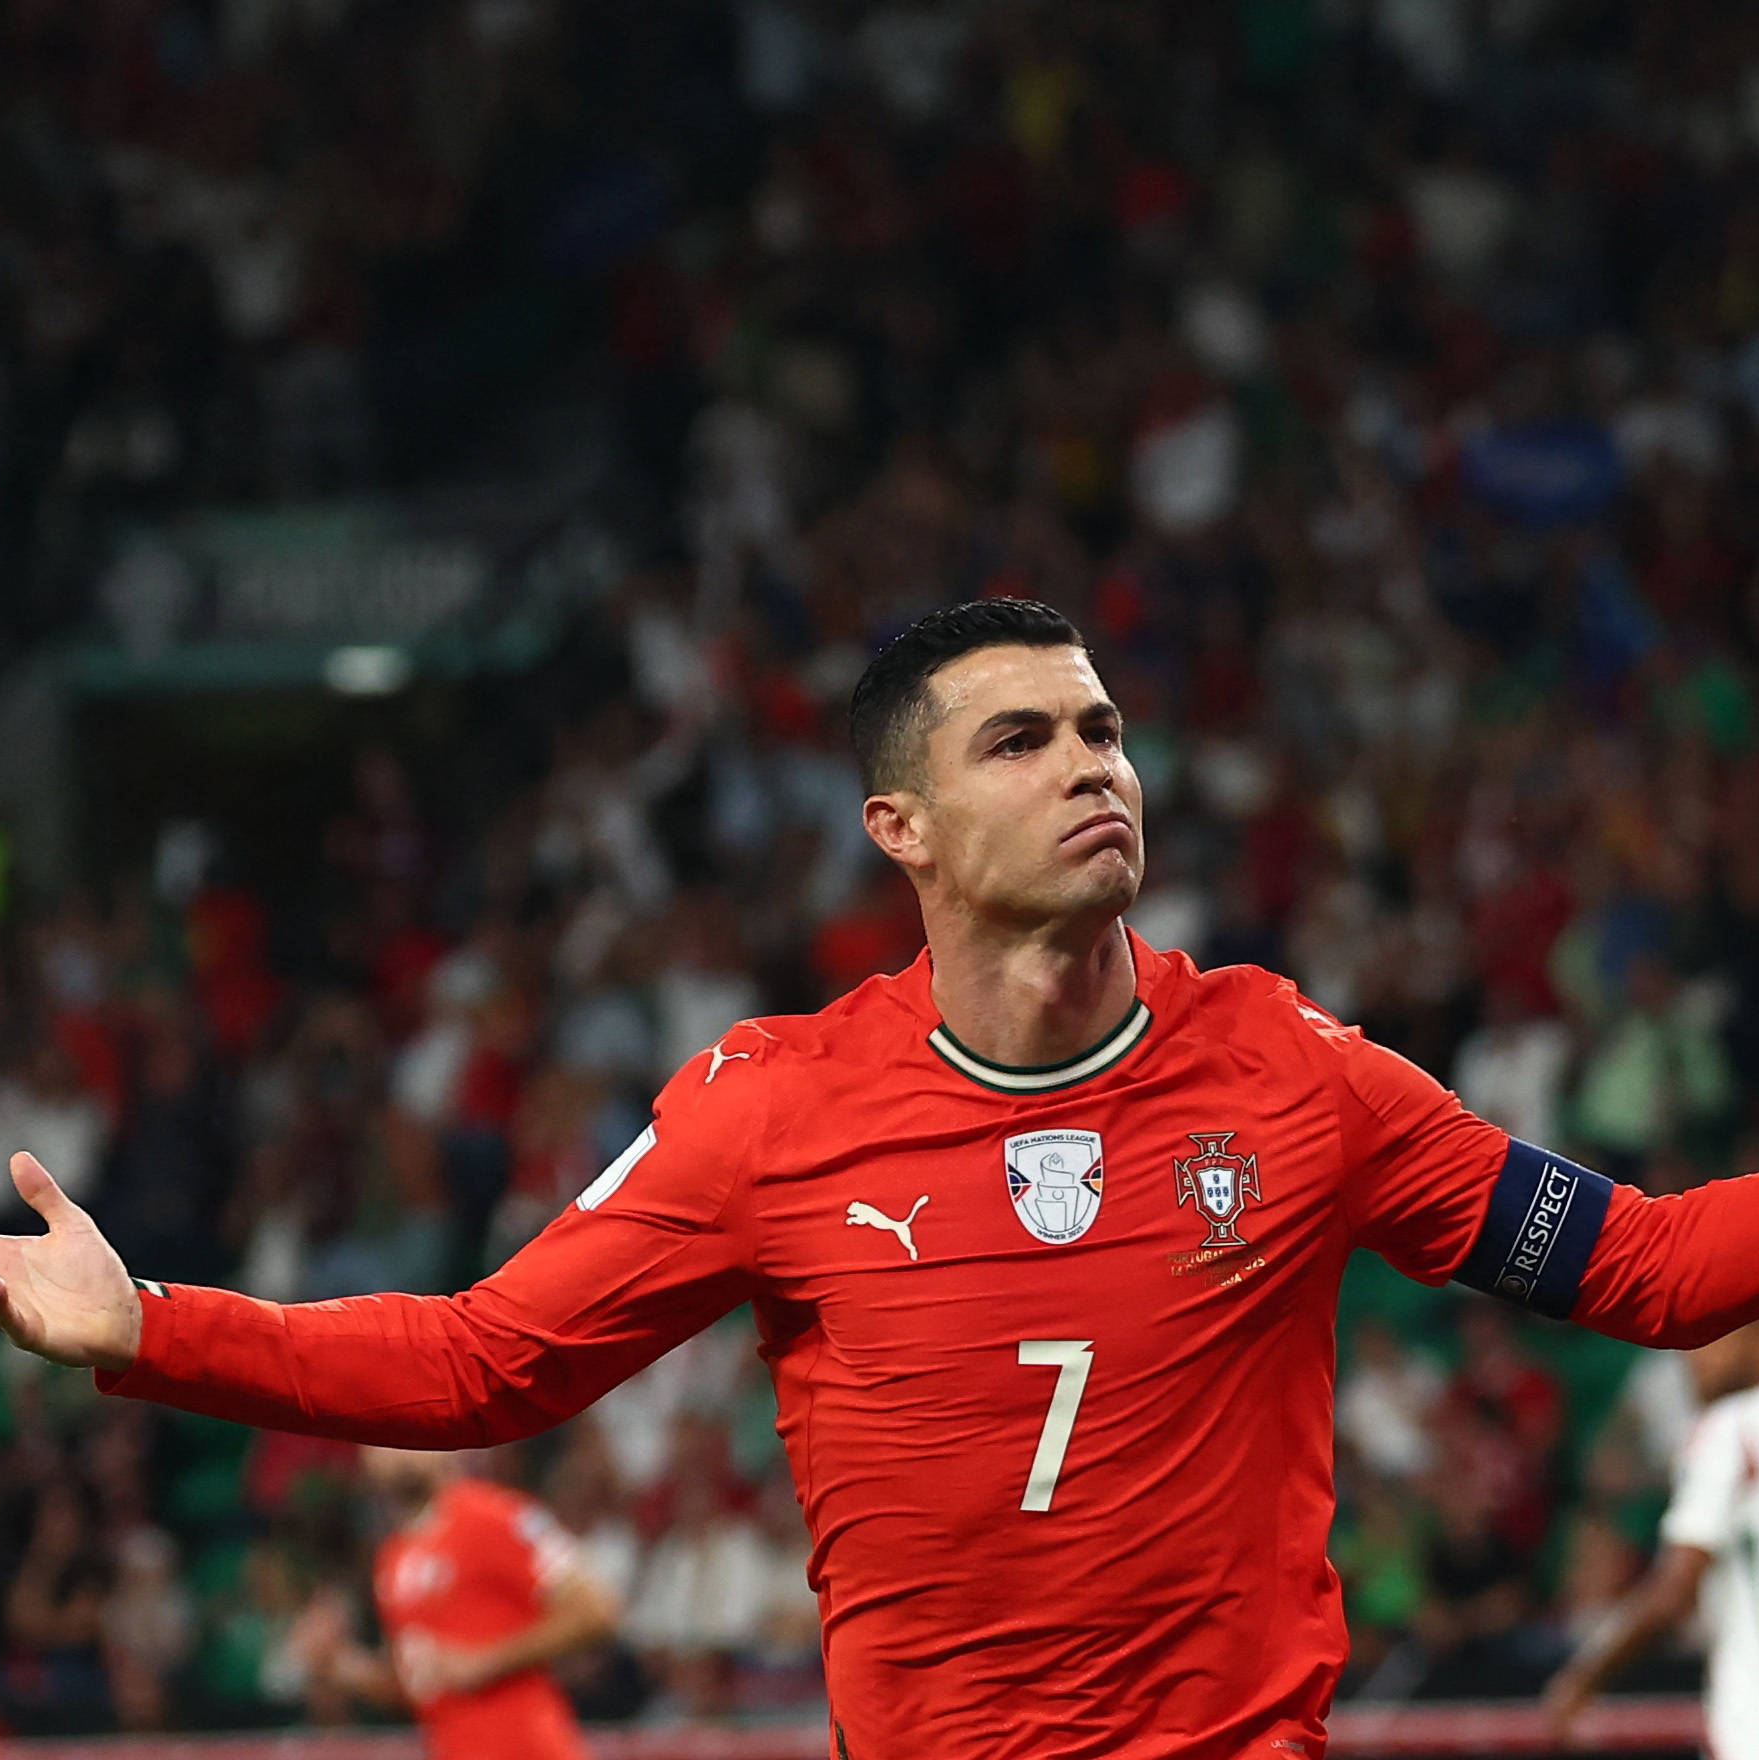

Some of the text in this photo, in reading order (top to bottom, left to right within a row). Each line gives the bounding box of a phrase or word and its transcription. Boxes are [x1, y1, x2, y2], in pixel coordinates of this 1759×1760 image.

[1010, 1134, 1096, 1148] UEFA NATIONS LEAGUE
[1037, 1228, 1066, 1240] WINNER
[1515, 1166, 1571, 1271] RESPECT
[1018, 1340, 1095, 1512] 7
